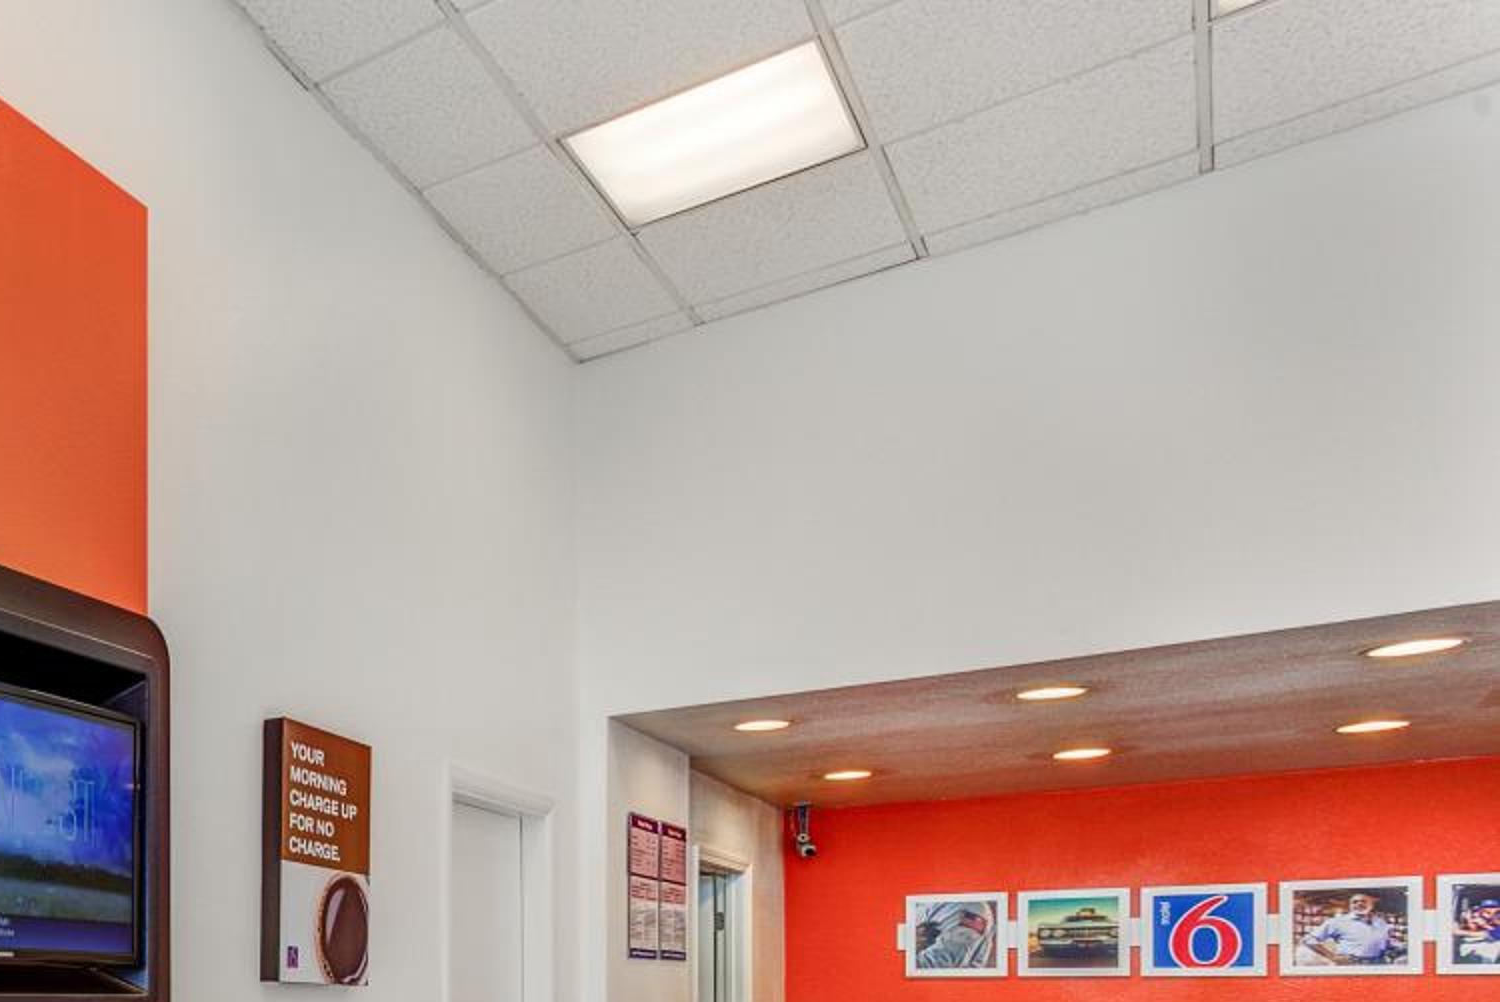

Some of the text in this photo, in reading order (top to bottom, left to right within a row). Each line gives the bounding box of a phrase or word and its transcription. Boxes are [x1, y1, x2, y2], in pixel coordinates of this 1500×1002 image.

[291, 741, 325, 766] YOUR
[290, 766, 347, 796] MORNING
[289, 789, 357, 820] CHARGE UP
[289, 813, 335, 837] FOR NO
[1168, 895, 1243, 970] 6
